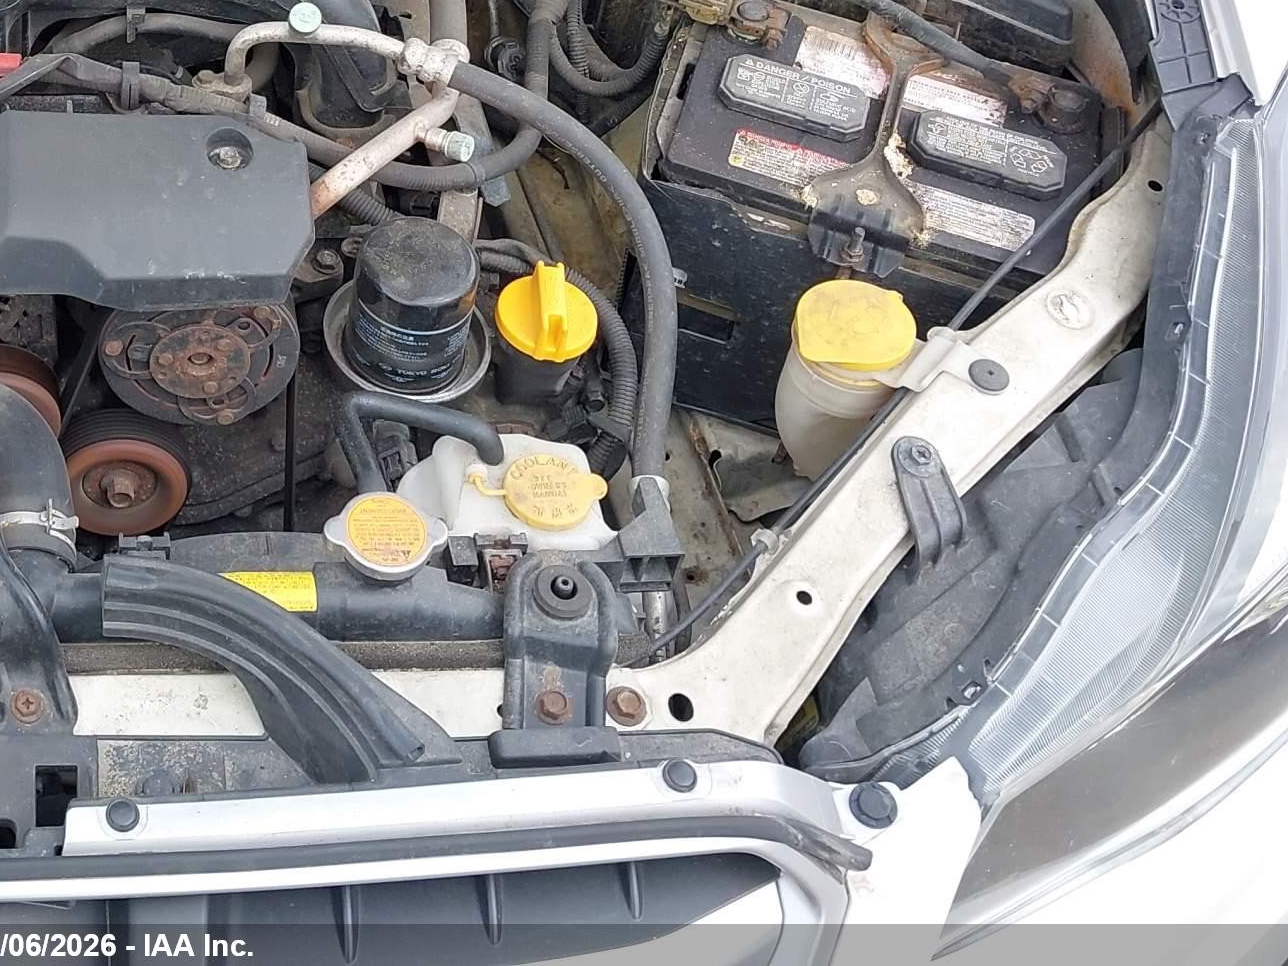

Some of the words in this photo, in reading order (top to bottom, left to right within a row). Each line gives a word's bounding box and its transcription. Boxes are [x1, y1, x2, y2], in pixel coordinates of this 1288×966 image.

[756, 61, 800, 81] DANGER
[810, 77, 852, 94] POISON
[510, 455, 579, 480] COOLANT
